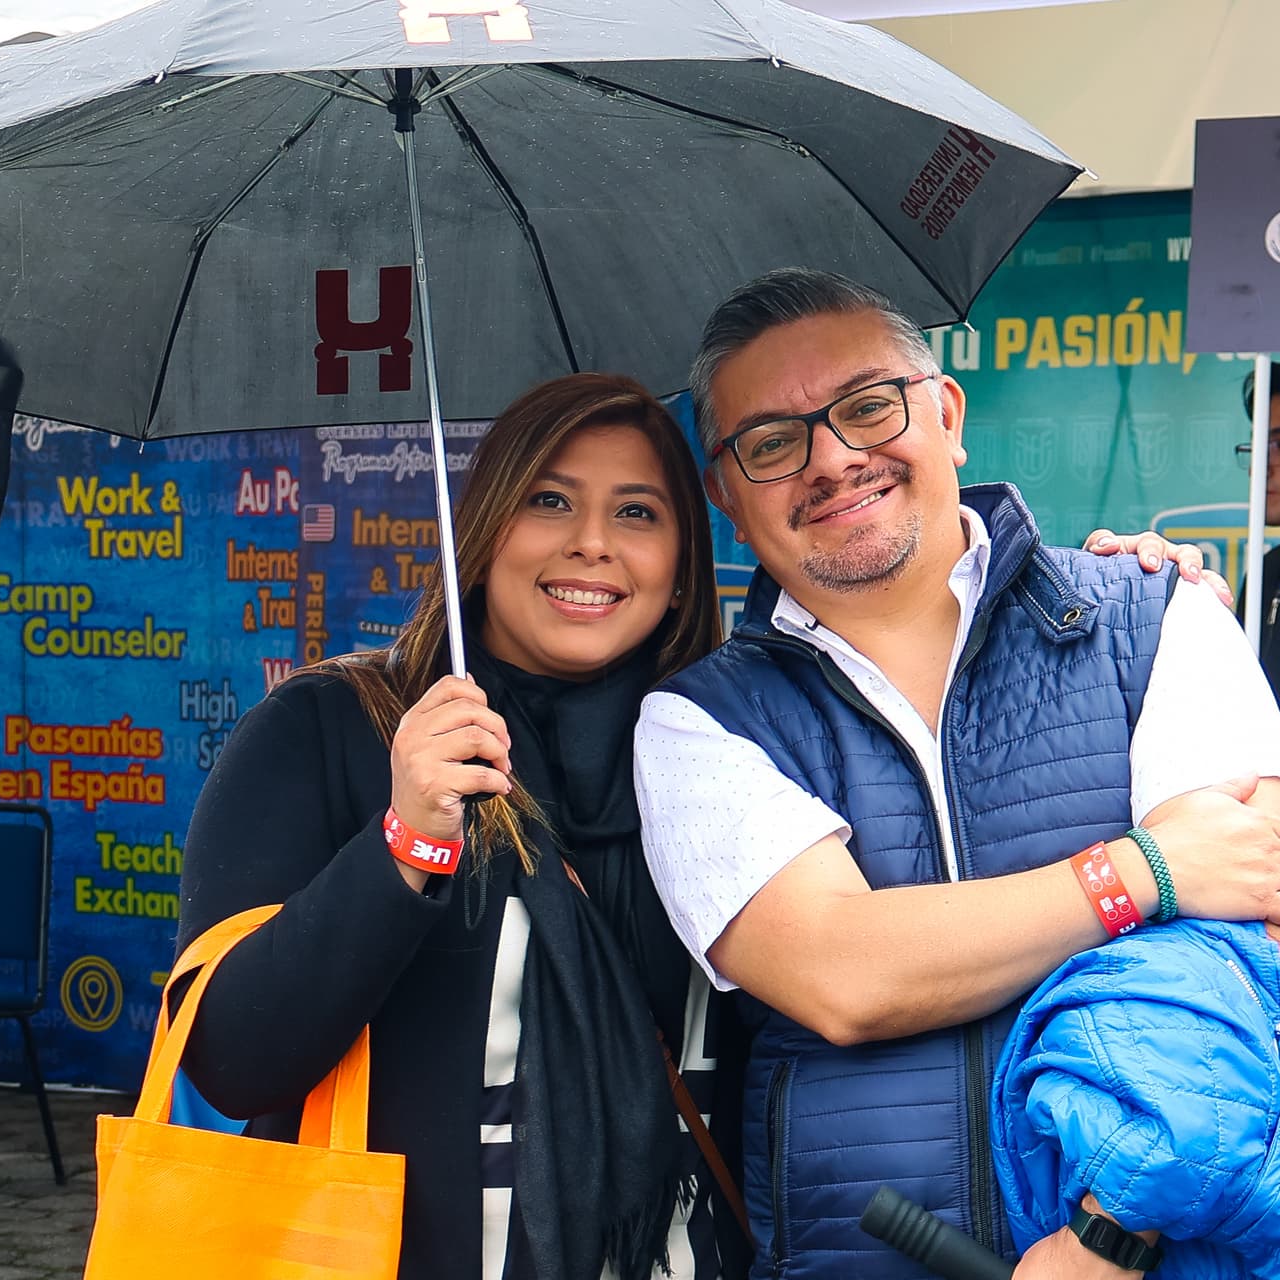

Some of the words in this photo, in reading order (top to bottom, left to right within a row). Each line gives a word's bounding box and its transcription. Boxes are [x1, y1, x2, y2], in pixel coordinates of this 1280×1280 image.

[995, 297, 1198, 375] PASIÓN,
[56, 472, 153, 516] Work
[159, 480, 182, 514] &
[236, 469, 270, 514] Au
[83, 516, 184, 559] Travel
[370, 565, 389, 594] &
[23, 615, 186, 658] Counselor
[243, 600, 258, 632] &
[180, 680, 238, 731] High
[4, 713, 163, 758] Pasantías
[50, 760, 165, 811] España
[410, 839, 453, 866] UHE
[75, 877, 181, 919] Exchan
